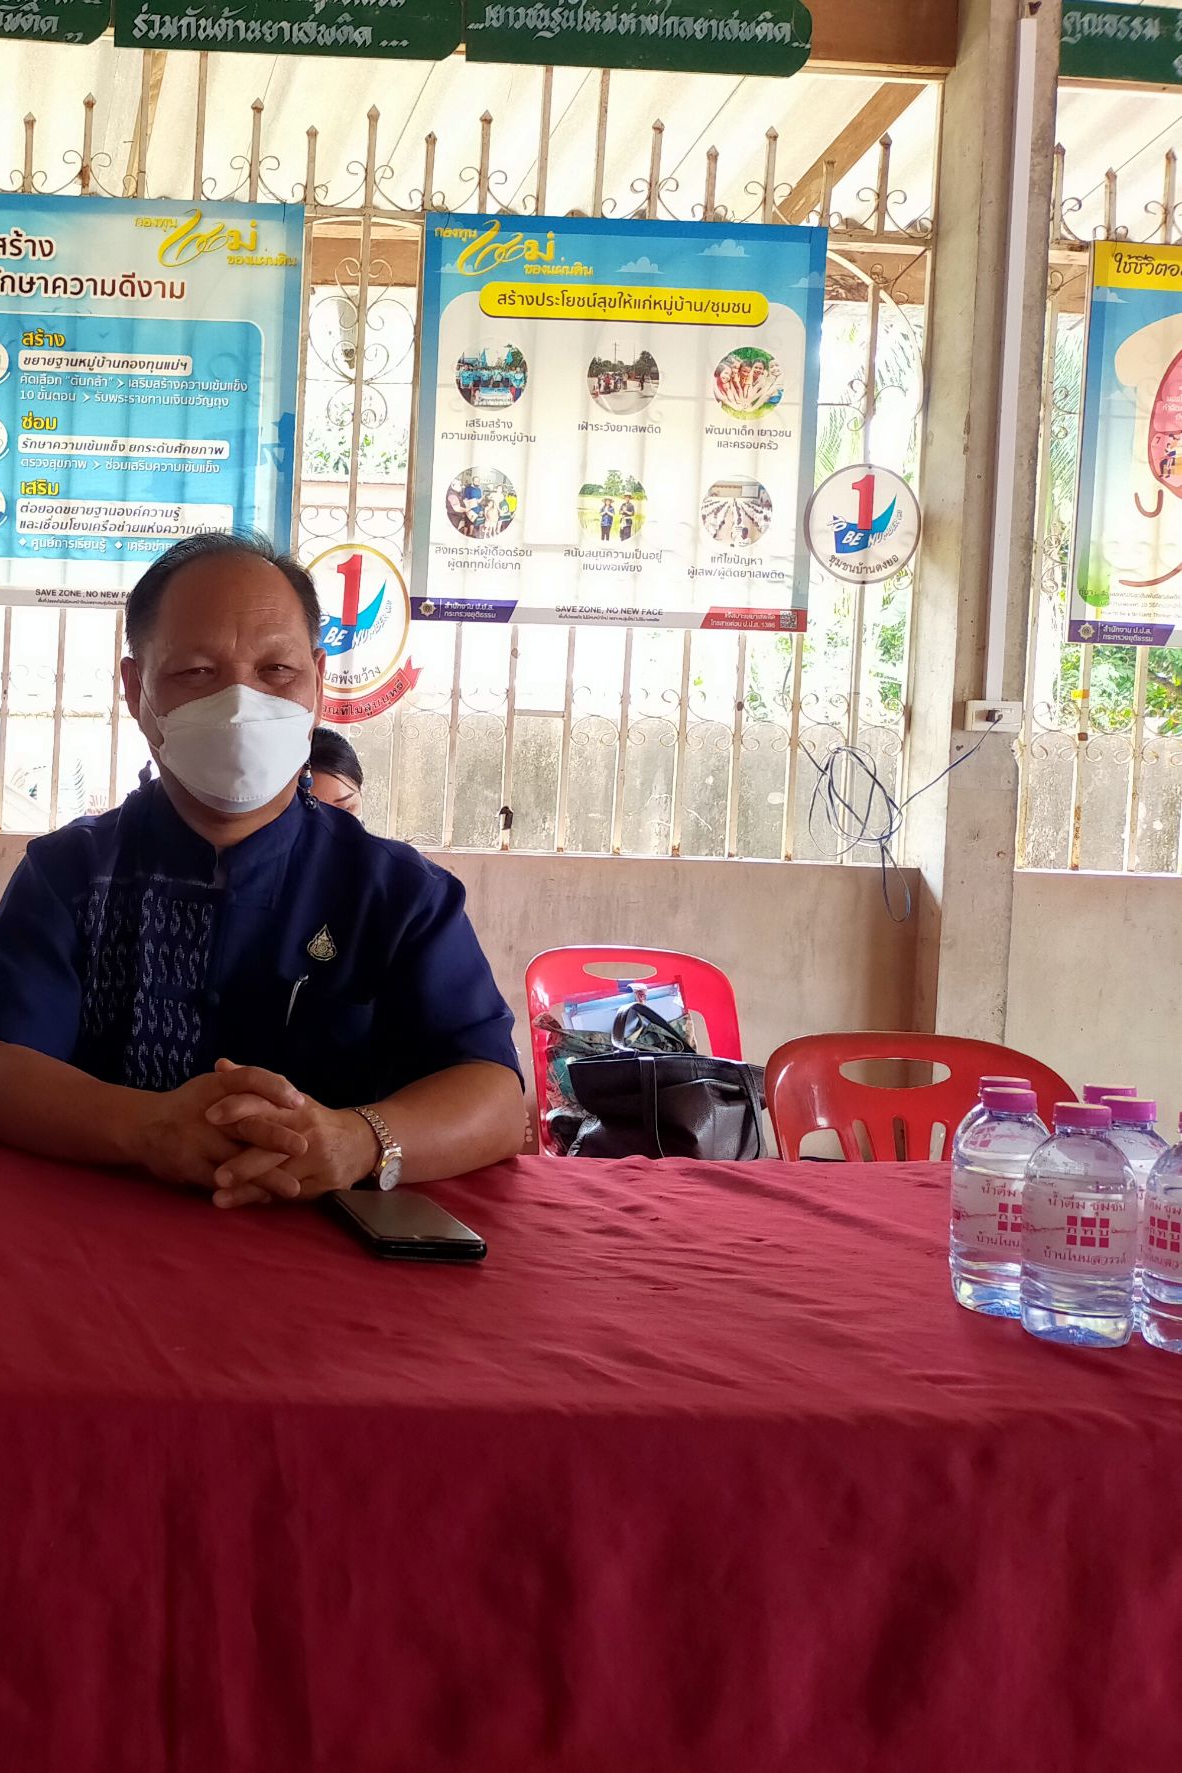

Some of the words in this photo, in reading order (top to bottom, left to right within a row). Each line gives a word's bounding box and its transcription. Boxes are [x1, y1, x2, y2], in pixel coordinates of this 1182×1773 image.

[1114, 252, 1182, 277] ใช้ชีวิตอ
[497, 289, 752, 317] สร้างประโยชน์สุขให้แก่หมู่บ้าน/ชุมชน
[22, 328, 66, 348] สร้าง
[23, 355, 188, 374] ขยายฐานหมู่บ้านกองทุนแม่ฯ
[20, 390, 34, 400] 10
[37, 386, 76, 402] ขั้นตอน
[21, 411, 58, 431] ซ่อม
[465, 416, 514, 430] เสริมสร้าง
[578, 420, 662, 435] เฝ้าระวังยาเสพติด
[441, 430, 537, 446] ความเข้มแข็งหมู่บ้าน
[705, 423, 755, 438] พัฒนาเด็ก
[757, 428, 792, 438] เยาวชน
[21, 437, 126, 452] รักษาความเข้มแข็ง
[128, 440, 225, 456] ยกระดับศักยภาพ
[717, 438, 779, 452] และครอบครัว
[20, 458, 87, 472] ตรวจสุขภาพ
[21, 478, 60, 496] เสริม
[851, 474, 875, 531] 1
[20, 502, 181, 522] ต่อยอดขยายฐานองค์ความรู้
[31, 536, 107, 553] ศูนย์การเรียนรู้
[841, 530, 865, 546] BE
[710, 552, 763, 567] แก้ไขปัญหา
[35, 588, 57, 597] SAVE
[85, 590, 99, 599] NO
[100, 590, 120, 599] NEW
[336, 553, 363, 627] 1
[555, 605, 577, 613] SAVE
[620, 607, 639, 615] NEW
[641, 608, 664, 616] FACE
[323, 626, 348, 647] BE
